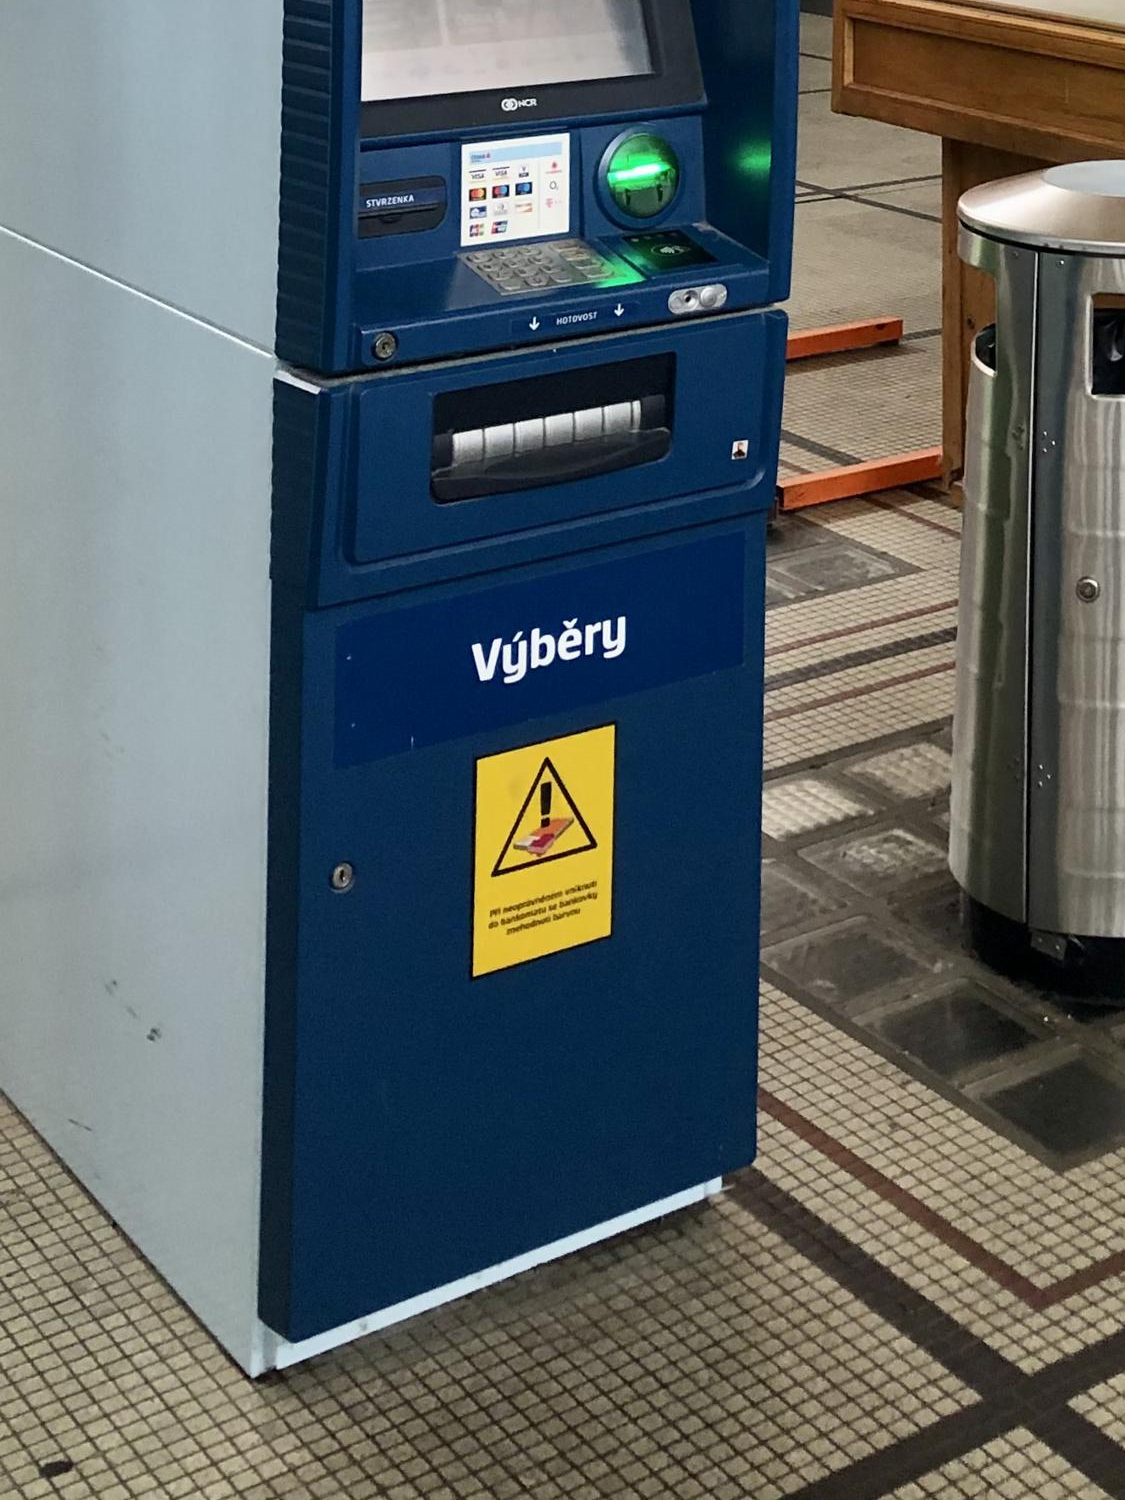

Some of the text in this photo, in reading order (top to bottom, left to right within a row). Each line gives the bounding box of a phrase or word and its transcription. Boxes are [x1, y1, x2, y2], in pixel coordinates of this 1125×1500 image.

[519, 98, 538, 108] NCR
[366, 194, 415, 209] STVRZENKA
[556, 311, 598, 326] HOTOVOST
[471, 615, 627, 685] Výběry
